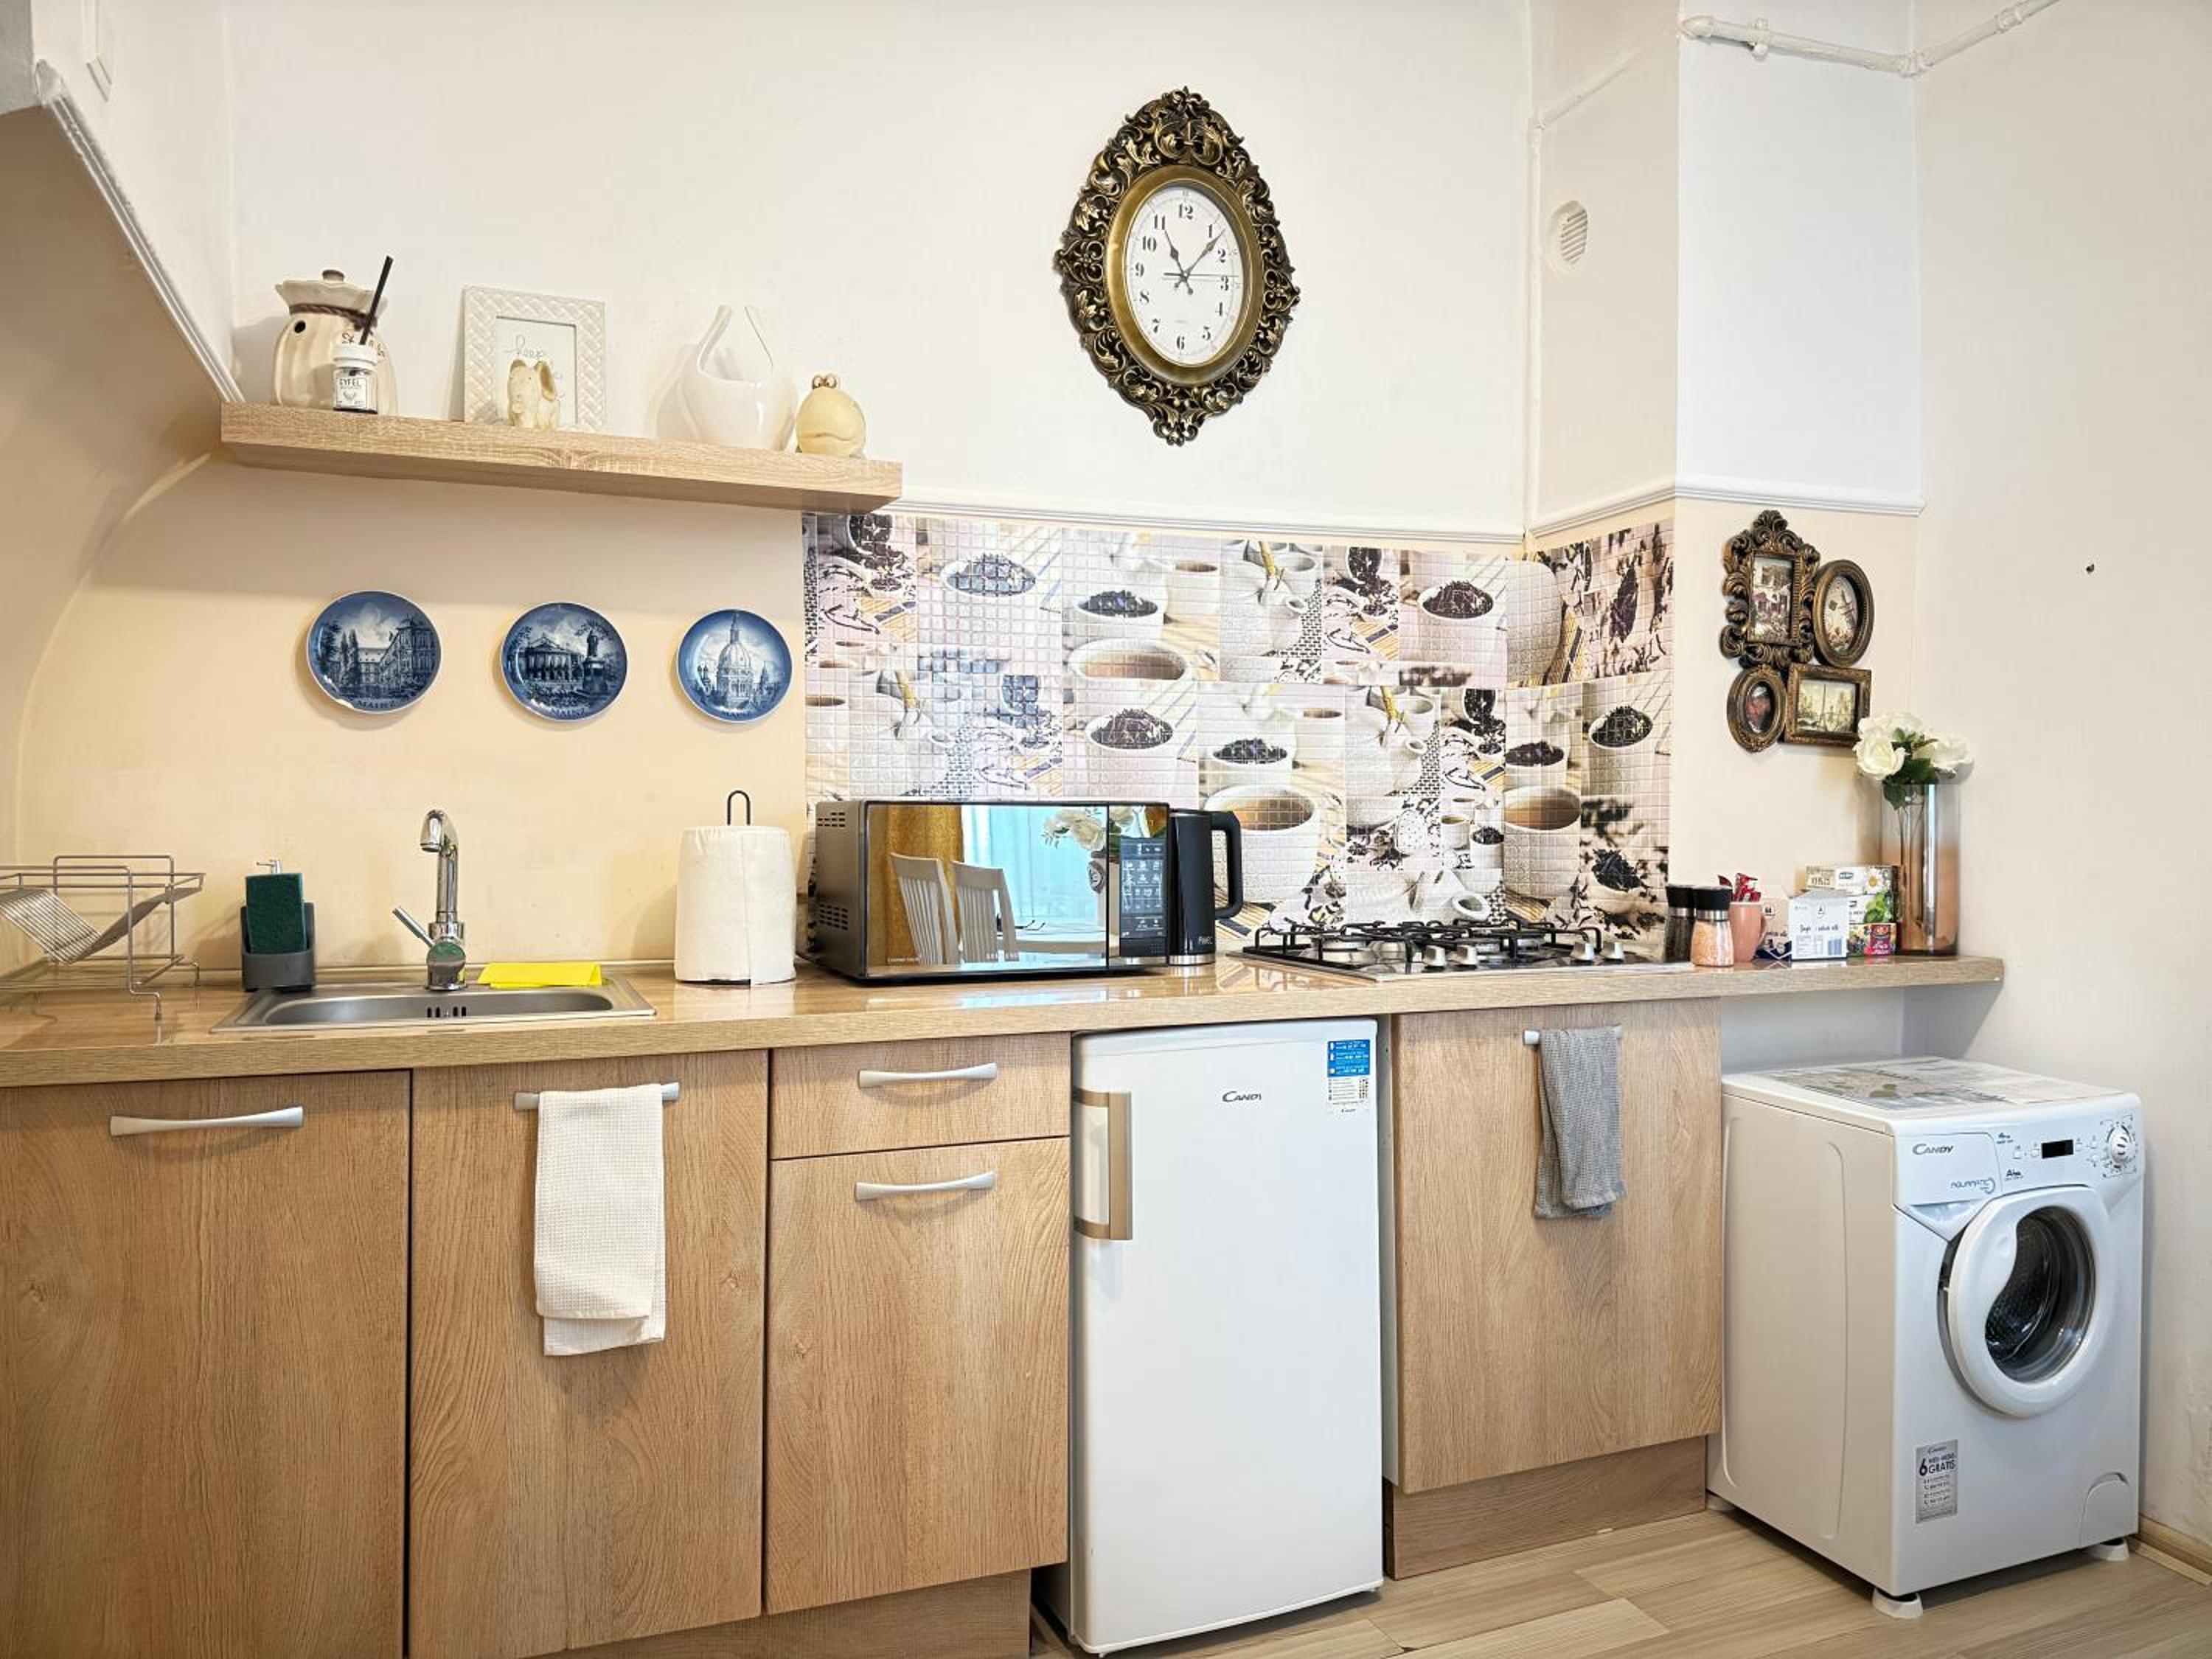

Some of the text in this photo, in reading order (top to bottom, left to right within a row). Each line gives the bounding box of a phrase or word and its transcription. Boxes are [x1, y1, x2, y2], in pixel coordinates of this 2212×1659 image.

[1179, 204, 1194, 220] 12
[1154, 215, 1166, 230] 11
[1208, 224, 1213, 238] 1
[1143, 236, 1157, 251] 10
[1217, 248, 1226, 263] 2
[1135, 262, 1144, 277] 9
[1220, 276, 1229, 291] 3
[1139, 291, 1150, 304] 8
[1215, 302, 1223, 316] 4
[1152, 318, 1161, 333] 7
[1203, 326, 1211, 341] 5
[1176, 335, 1185, 350] 6
[1912, 1144, 1953, 1155] CANDY
[1919, 1458, 1927, 1476] 6
